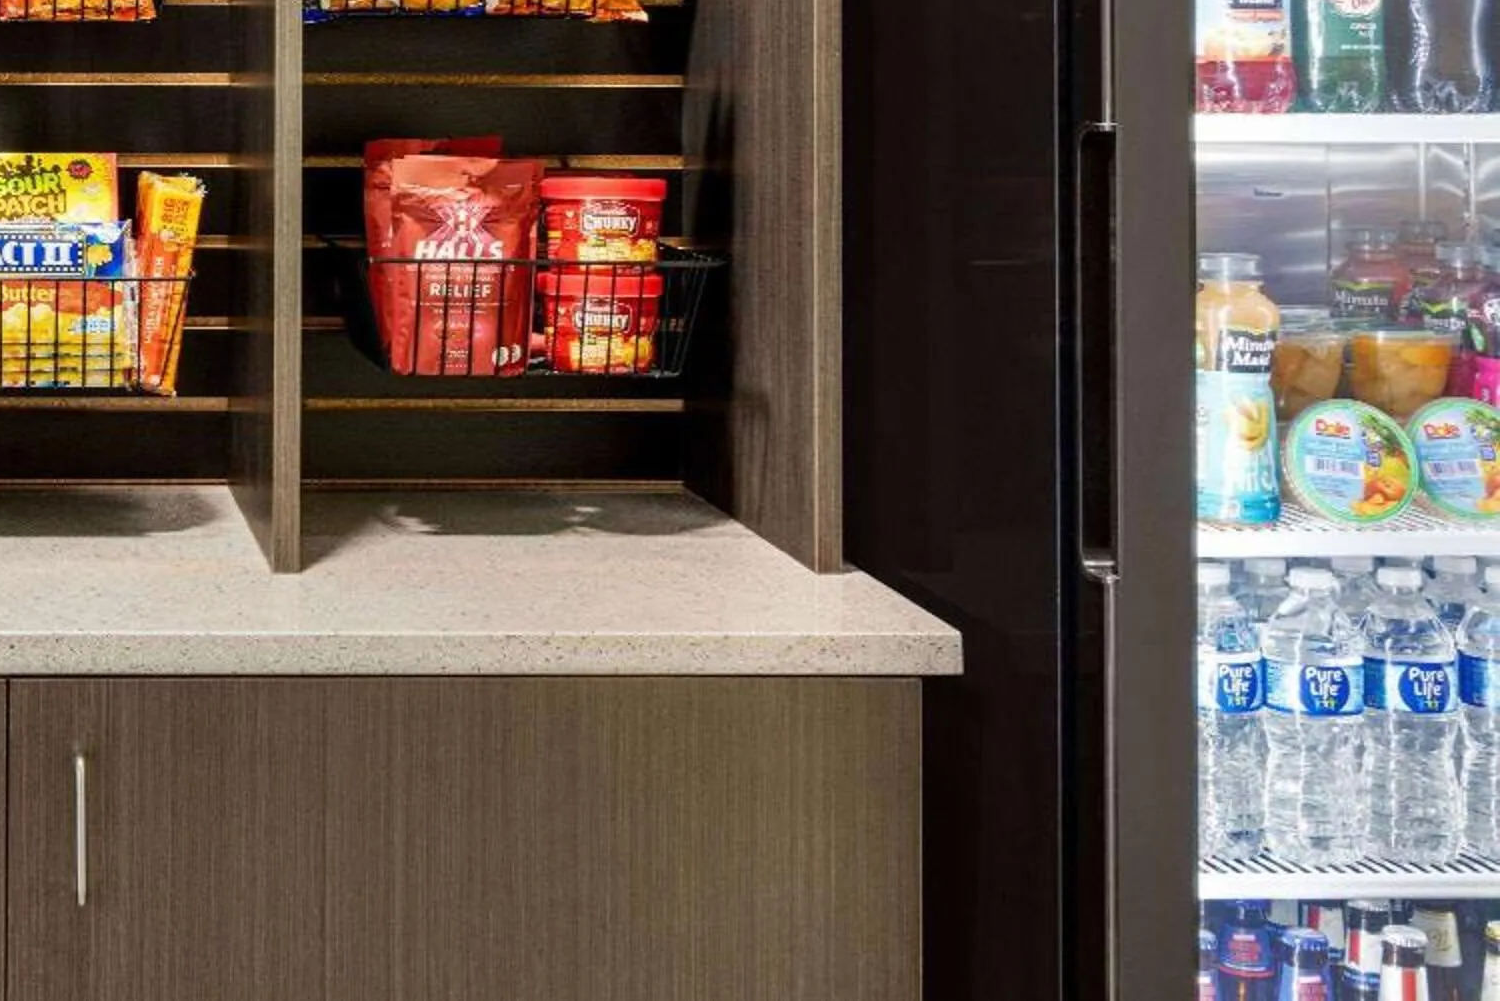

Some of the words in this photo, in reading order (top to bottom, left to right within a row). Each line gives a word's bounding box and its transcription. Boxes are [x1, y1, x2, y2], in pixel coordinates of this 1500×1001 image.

[583, 215, 637, 231] CHUNKY
[42, 242, 73, 266] II
[414, 240, 505, 261] HALLS
[430, 283, 492, 297] RELIEF
[1423, 423, 1461, 438] Dole
[1219, 665, 1253, 679] Pure
[1305, 666, 1343, 682] Pure
[1409, 666, 1445, 682] Pure
[1223, 680, 1250, 697] Life
[1310, 681, 1340, 698] Life
[1414, 681, 1442, 698] Life
